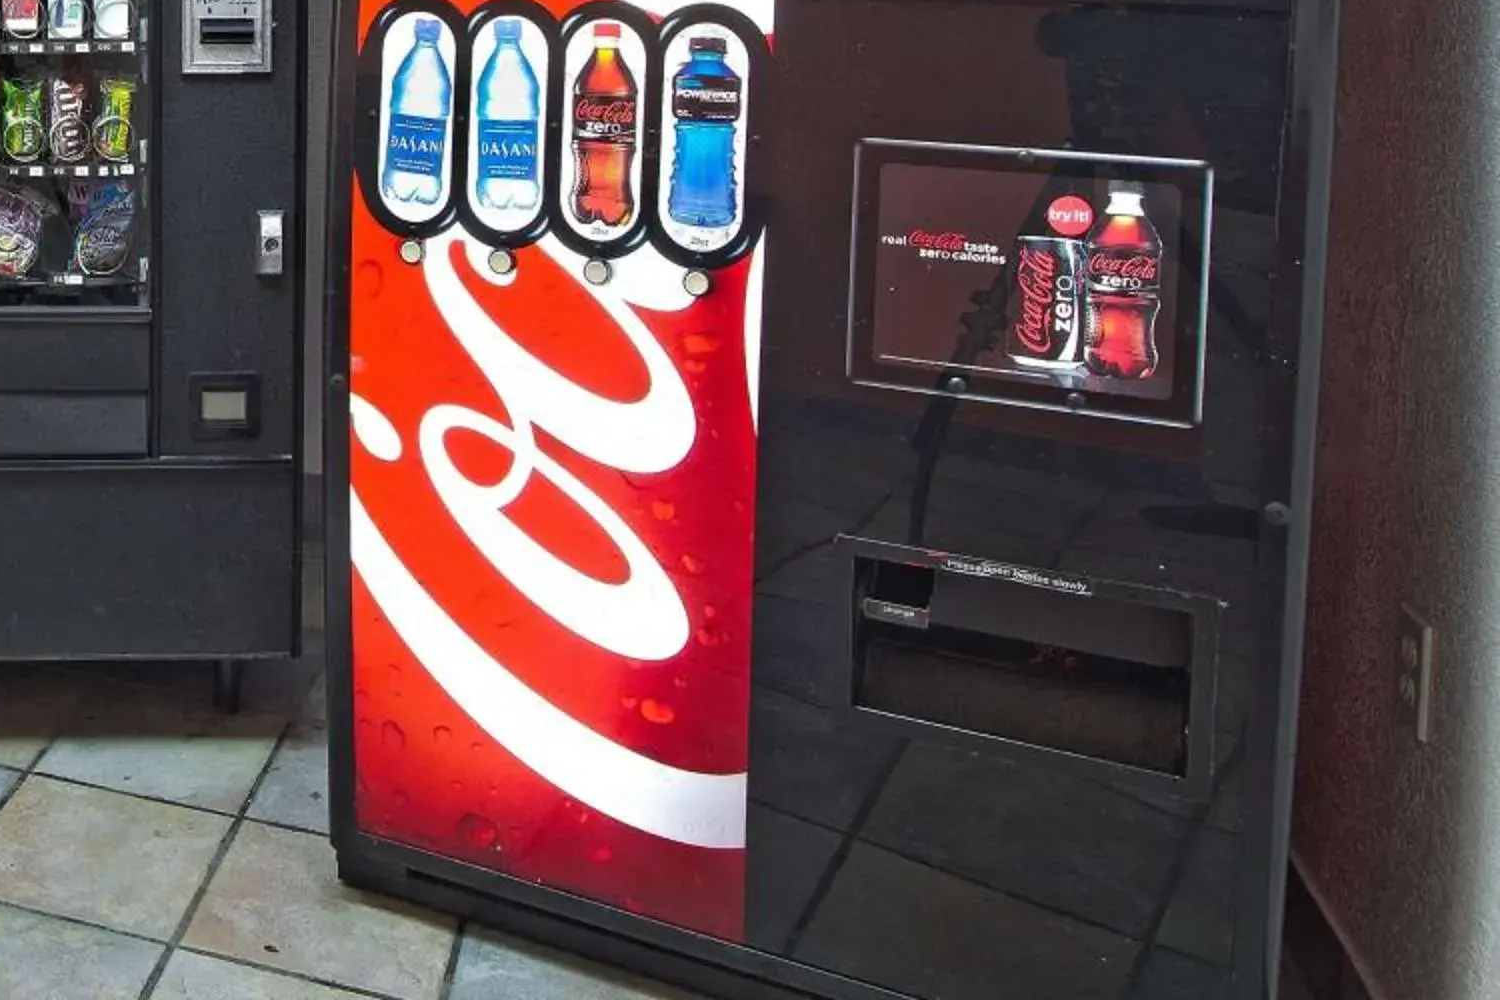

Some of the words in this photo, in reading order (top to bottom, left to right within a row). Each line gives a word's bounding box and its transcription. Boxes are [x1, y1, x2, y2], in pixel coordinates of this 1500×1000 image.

[584, 121, 621, 133] zero
[1047, 209, 1071, 224] try
[881, 235, 907, 246] real
[964, 241, 999, 254] taste
[919, 248, 951, 259] zero
[951, 250, 1007, 265] calories
[1100, 274, 1142, 289] zero
[1054, 275, 1075, 332] zero
